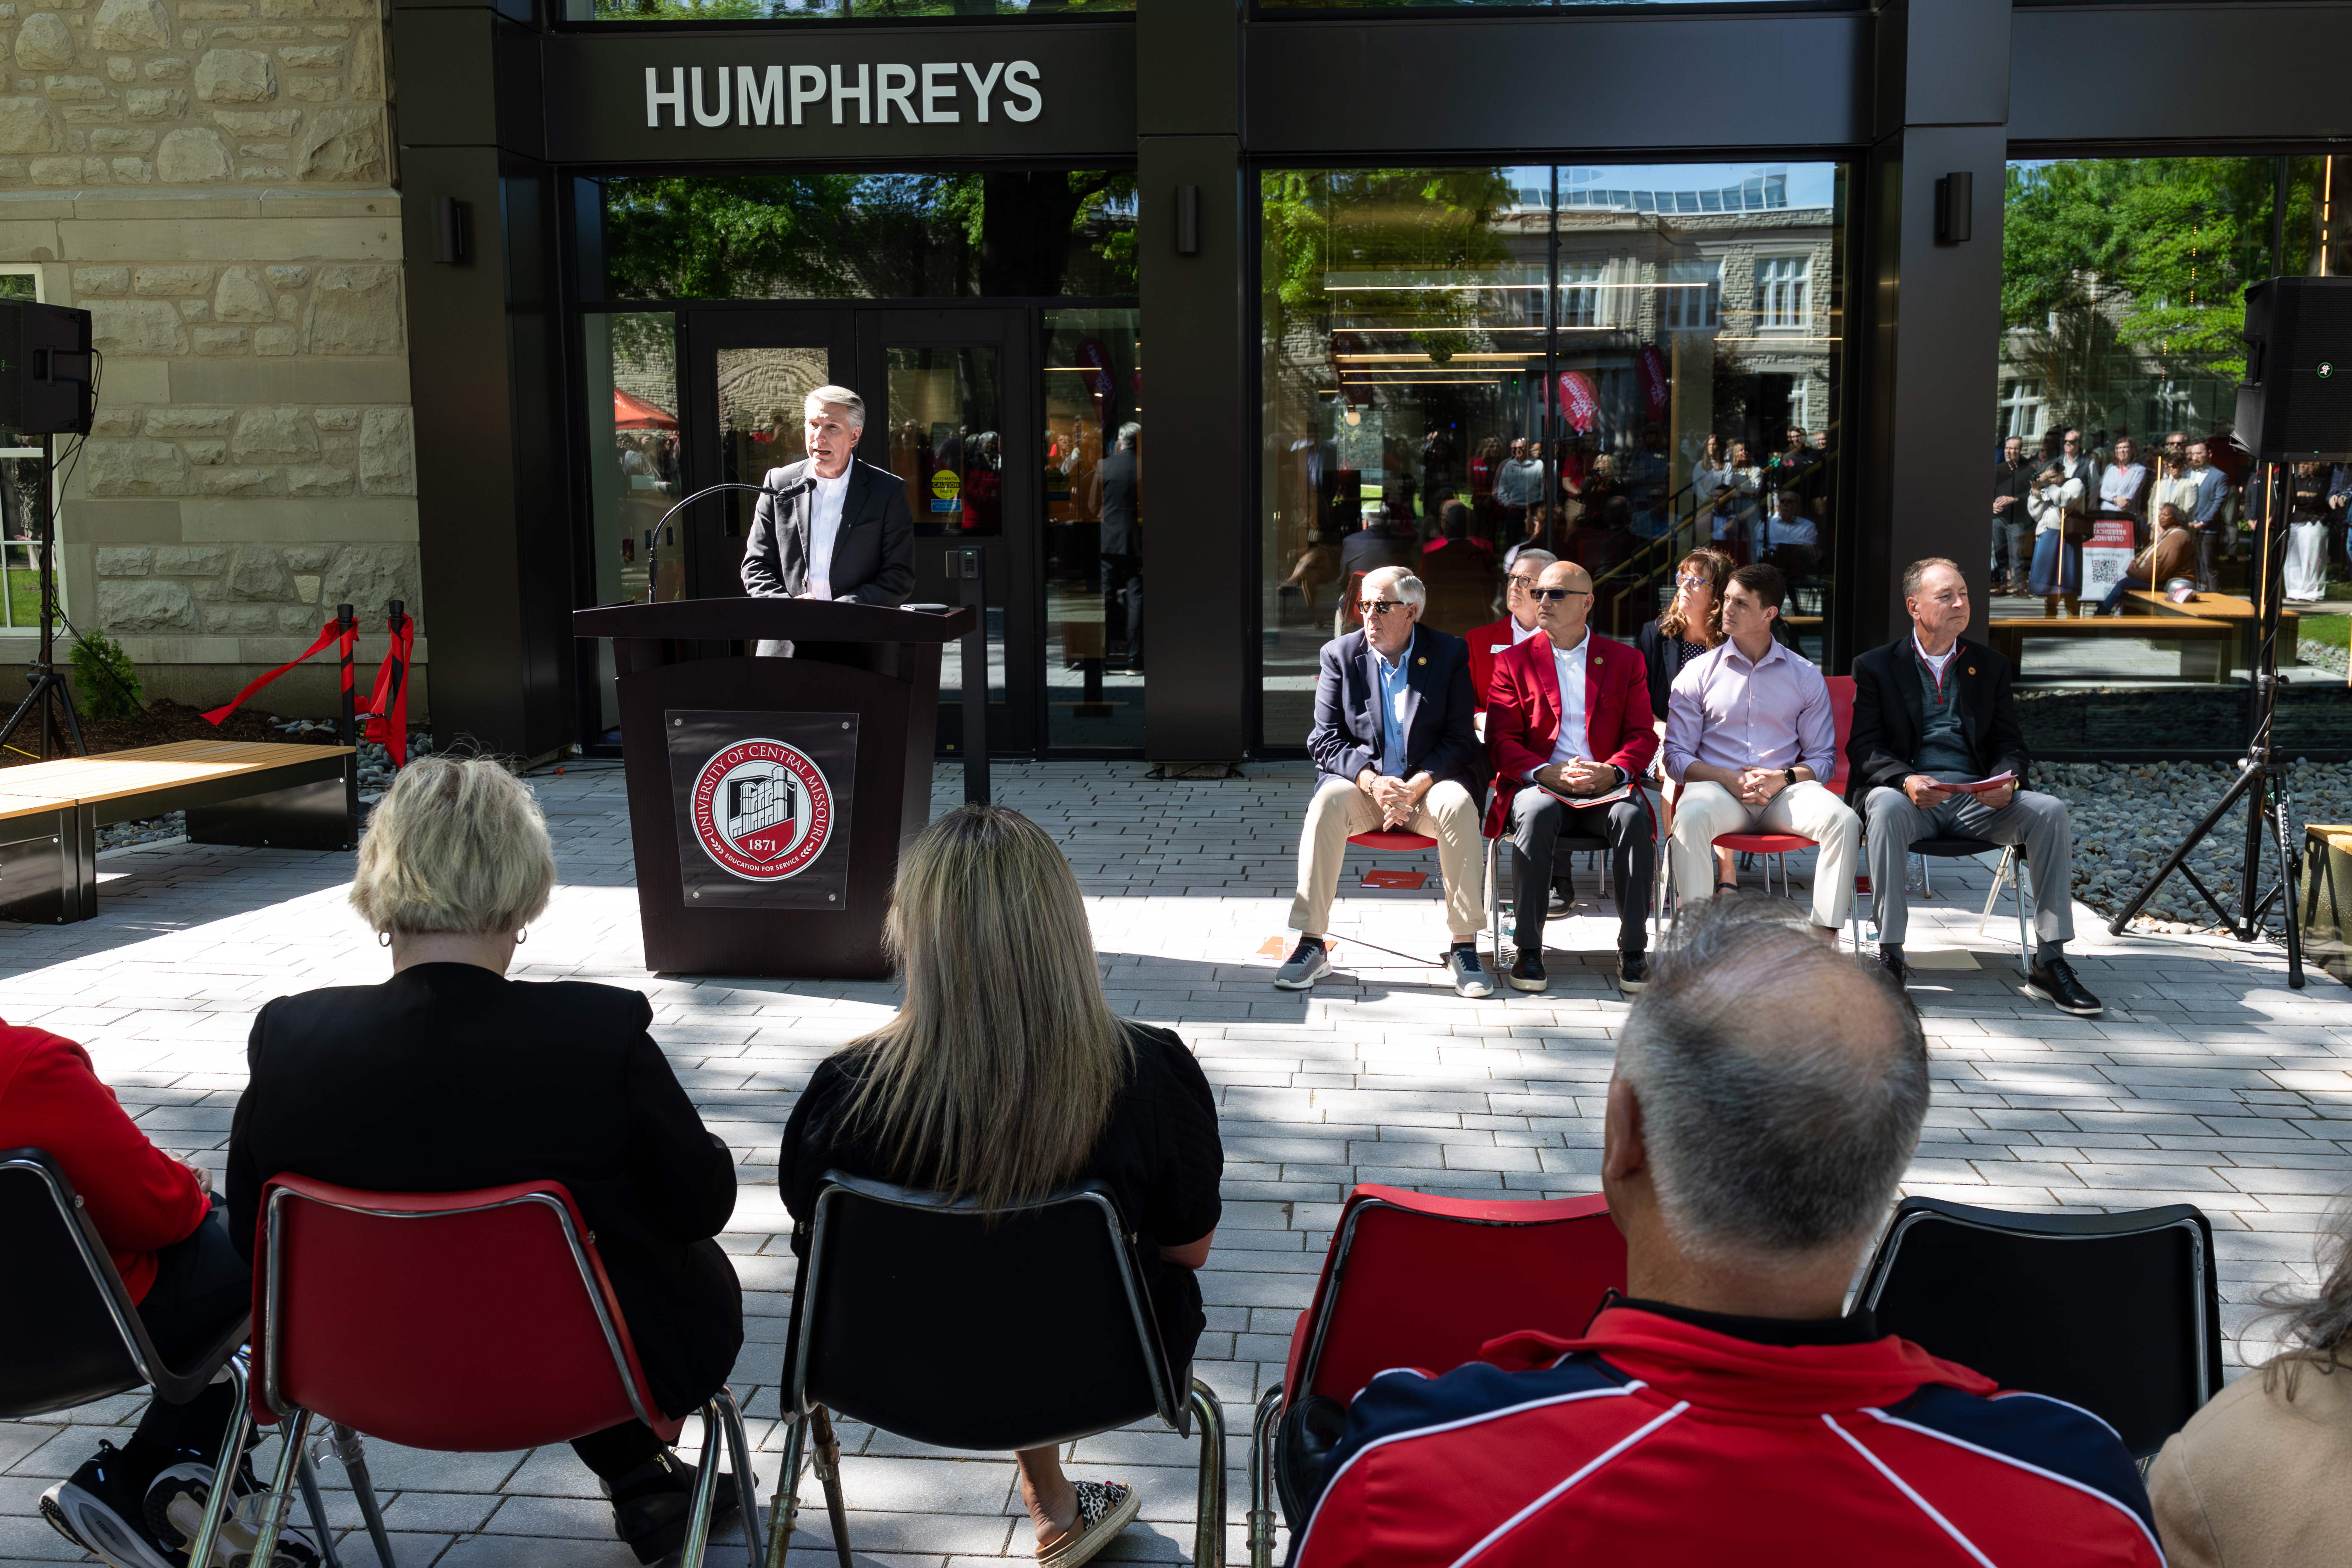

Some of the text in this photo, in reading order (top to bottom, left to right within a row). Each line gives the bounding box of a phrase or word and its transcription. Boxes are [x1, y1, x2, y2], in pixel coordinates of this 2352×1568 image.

[646, 61, 1042, 127] HUMPHREYS
[698, 746, 827, 842] UNIVERSITY OF CENTRAL MISSOURI
[2282, 790, 2292, 862] ULTIMATE
[724, 853, 759, 871] EDUCATION
[775, 856, 800, 870] SERVICE
[748, 839, 776, 851] 1871
